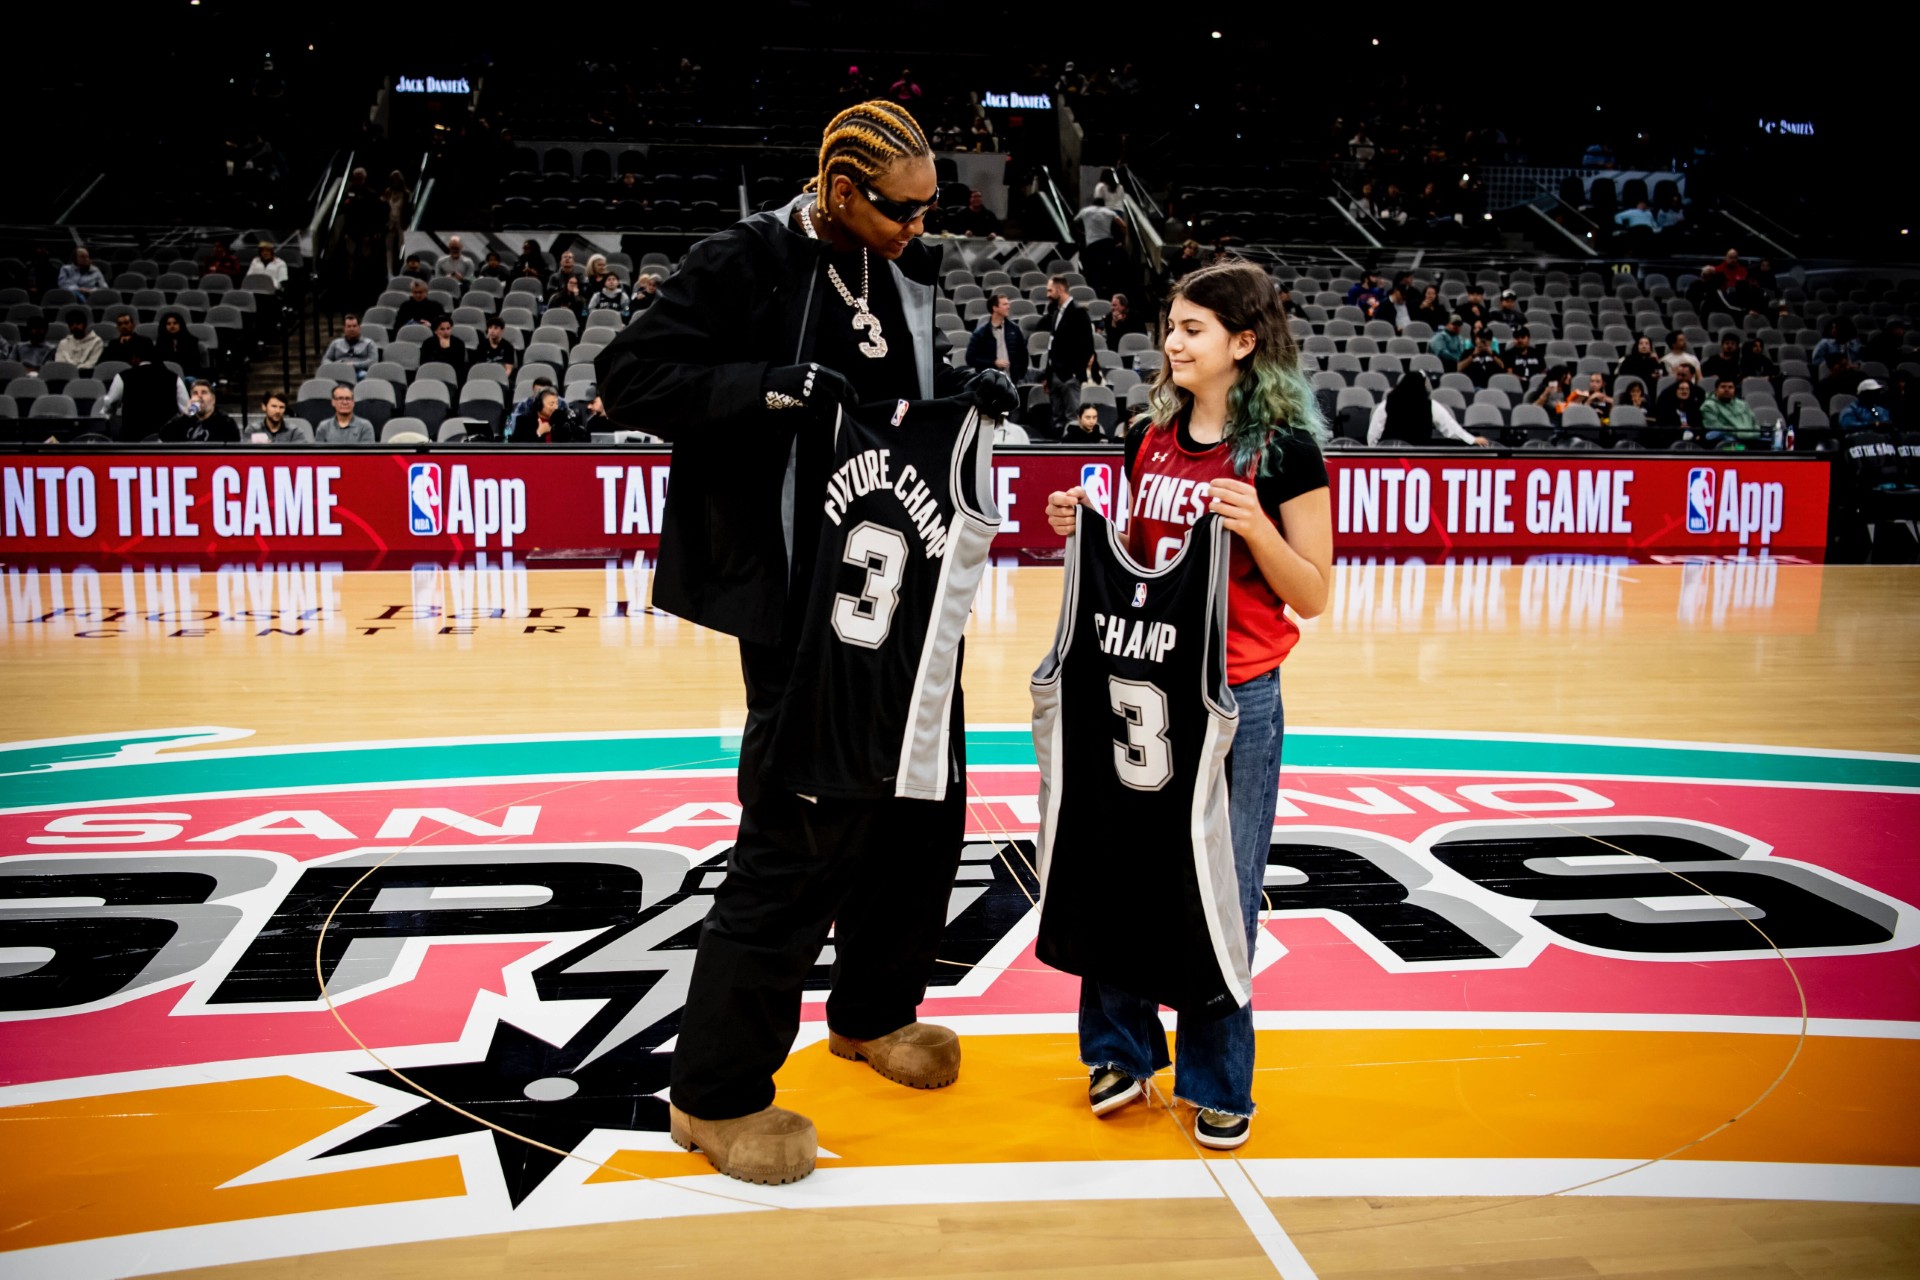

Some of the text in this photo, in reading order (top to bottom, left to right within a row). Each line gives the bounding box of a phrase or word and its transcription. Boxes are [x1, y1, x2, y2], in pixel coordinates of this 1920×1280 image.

[109, 466, 199, 537] THE
[212, 465, 342, 537] GAME
[446, 464, 526, 547] App
[894, 464, 949, 560] CHAMP
[1133, 473, 1220, 526] FINES
[1338, 467, 1634, 534] INTO THE GAME
[1716, 469, 1783, 544] App
[830, 519, 910, 650] 3
[74, 625, 566, 639] CENTER
[1094, 613, 1176, 663] CHAMP
[1108, 674, 1174, 791] 3
[26, 805, 542, 845] SAN
